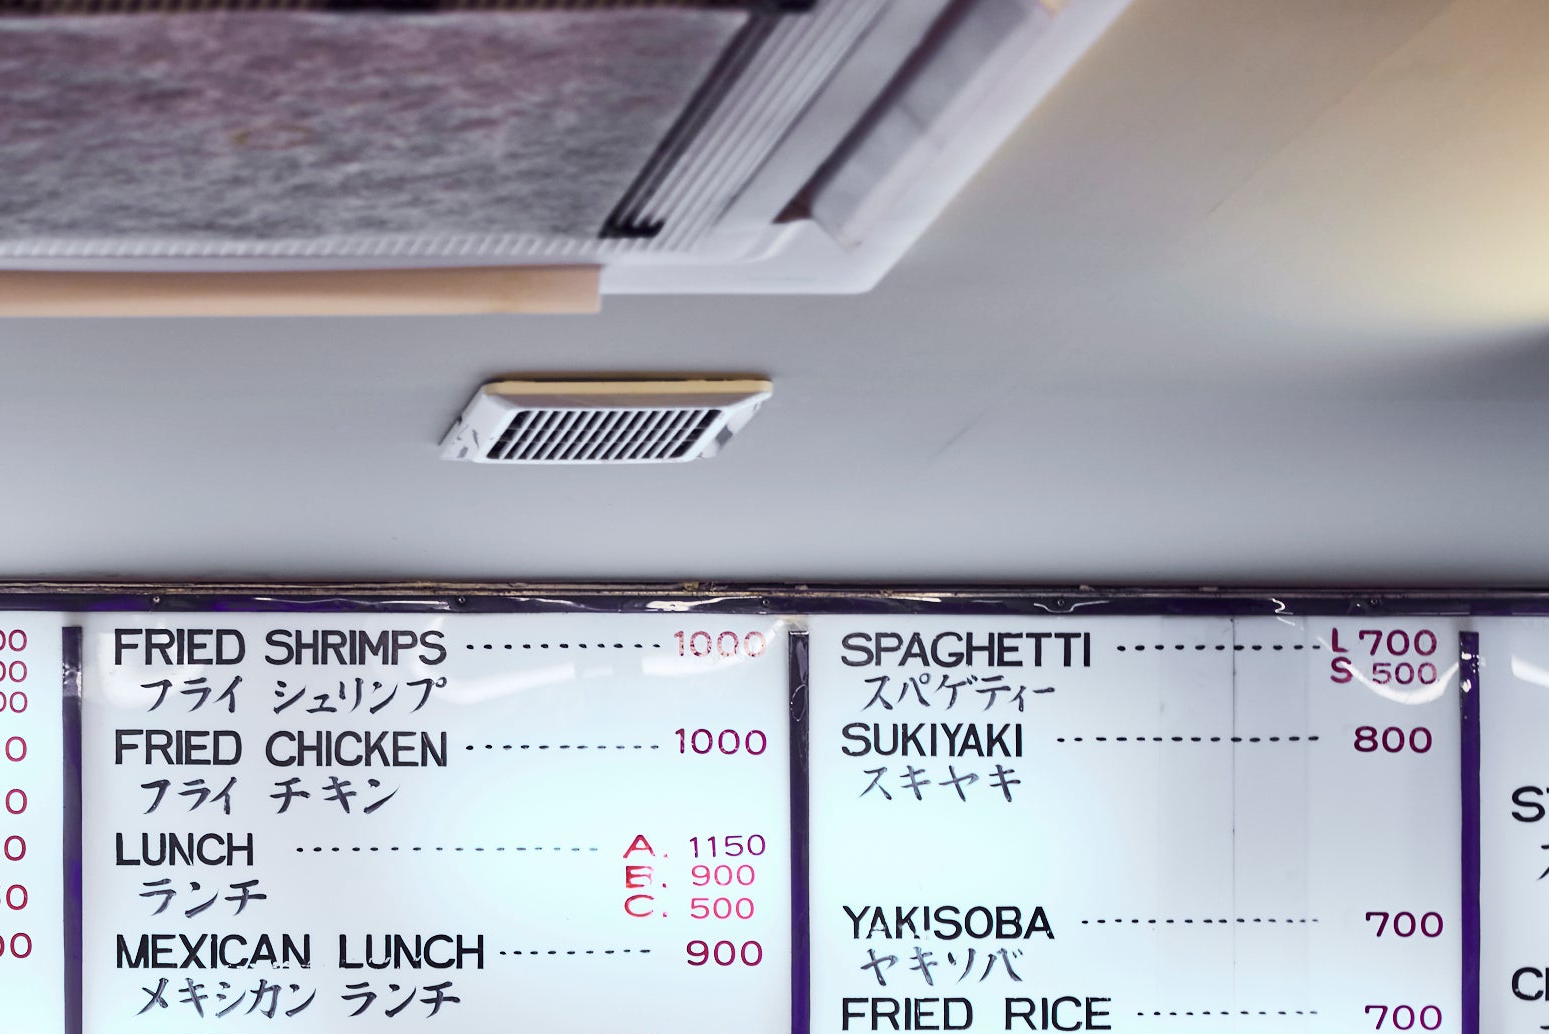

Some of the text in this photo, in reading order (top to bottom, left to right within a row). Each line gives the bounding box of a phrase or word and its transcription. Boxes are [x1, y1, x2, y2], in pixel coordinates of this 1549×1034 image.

[114, 627, 763, 666] FRIED SHRIMPS 1000
[840, 628, 1438, 669] SPAGHETTI 700
[862, 672, 1056, 713] スパゲティー
[1371, 661, 1437, 686] 500
[139, 674, 448, 716] フライ シュリンプ
[114, 727, 768, 768] FRIED CHICKEN 1000
[841, 721, 1433, 758] SUKIYAKI 800
[140, 775, 399, 816] フライ チキン
[859, 763, 1022, 803] スキヤキ
[115, 832, 766, 867] LUNCH A. 1150
[691, 864, 756, 887] 900
[138, 877, 268, 919] ランチ
[623, 893, 755, 920] C. 500
[842, 904, 1444, 941] YAKISOBA 700
[116, 933, 763, 970] MEXICAN LUNCH 900
[859, 945, 1024, 988] ヤキソバ
[136, 976, 462, 1020] メキシカン ランチ
[841, 995, 1443, 1032] FRIED RICE 700
